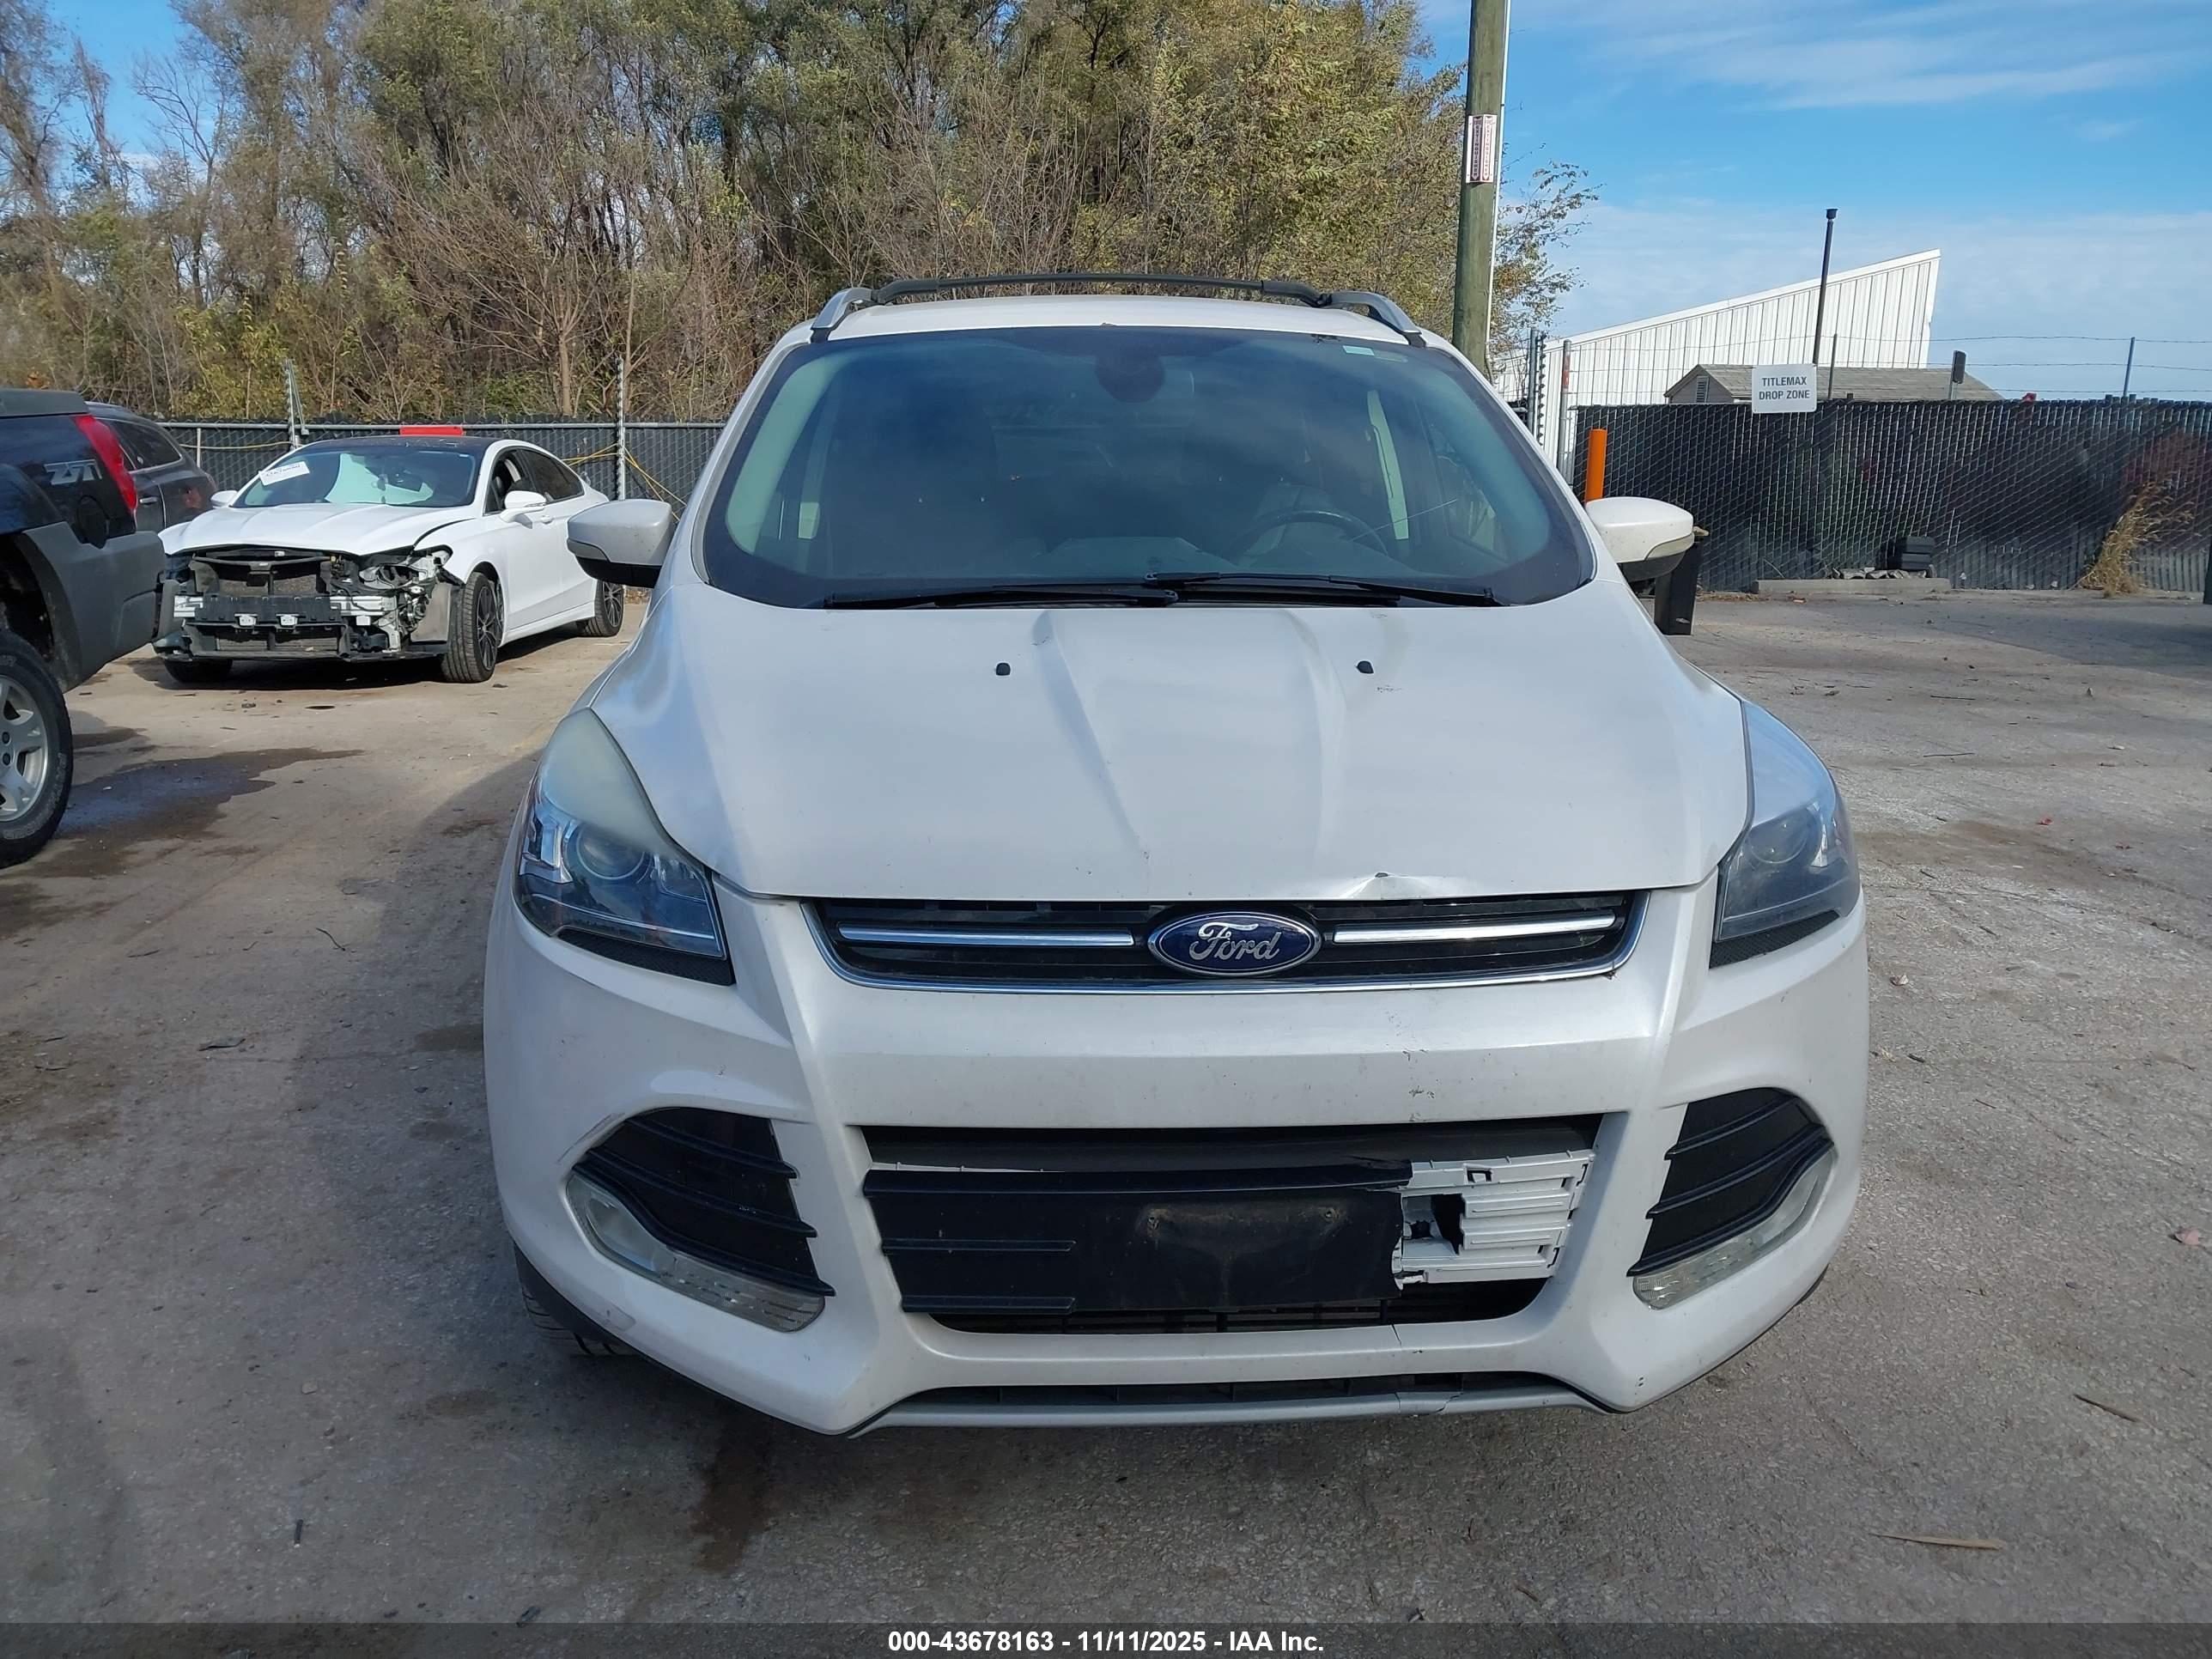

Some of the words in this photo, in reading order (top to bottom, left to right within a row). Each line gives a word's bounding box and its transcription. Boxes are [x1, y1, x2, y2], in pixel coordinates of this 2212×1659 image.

[1762, 376, 1807, 386] TITLEMAX
[1759, 391, 1784, 400] DROP
[1786, 390, 1810, 399] ZONE
[1188, 921, 1282, 960] Ford
